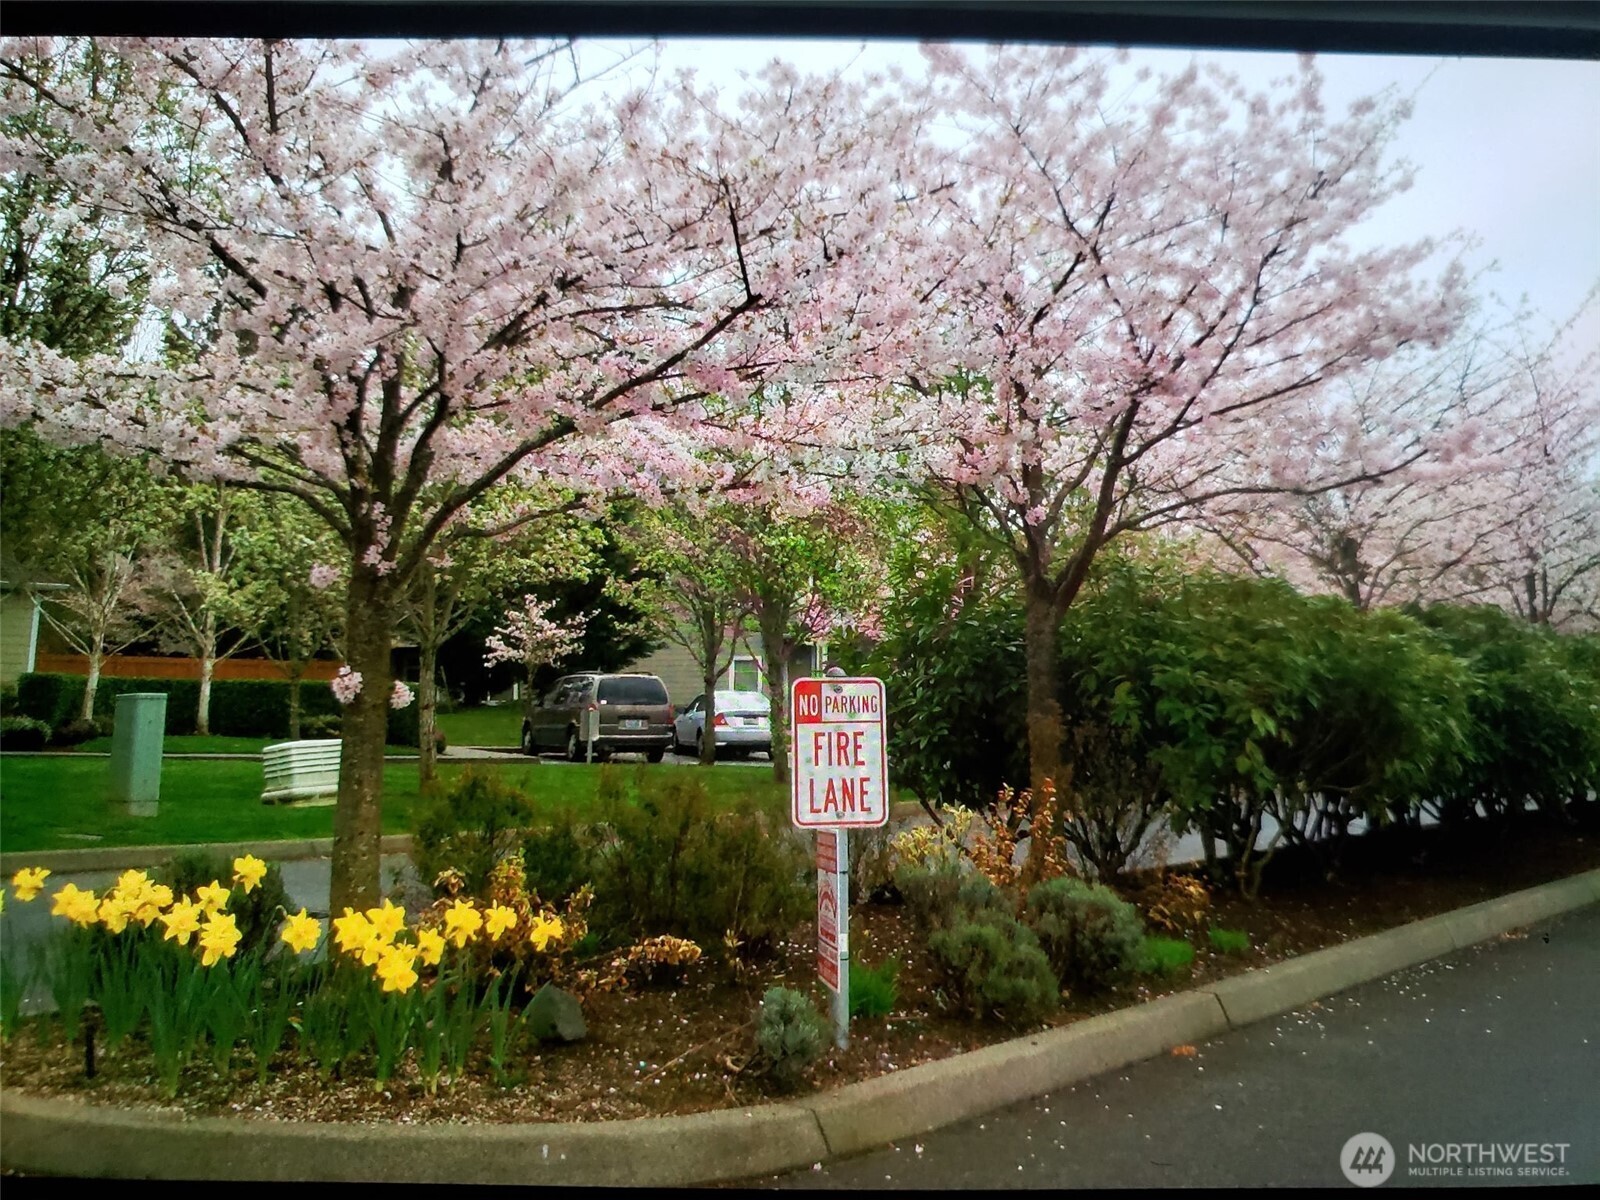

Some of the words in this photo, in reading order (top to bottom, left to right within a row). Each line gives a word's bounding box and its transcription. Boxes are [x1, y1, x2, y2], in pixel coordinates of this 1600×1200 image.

[799, 694, 819, 716] NO
[825, 695, 878, 714] PARKING
[814, 731, 866, 767] FIRE
[809, 777, 872, 814] LANE
